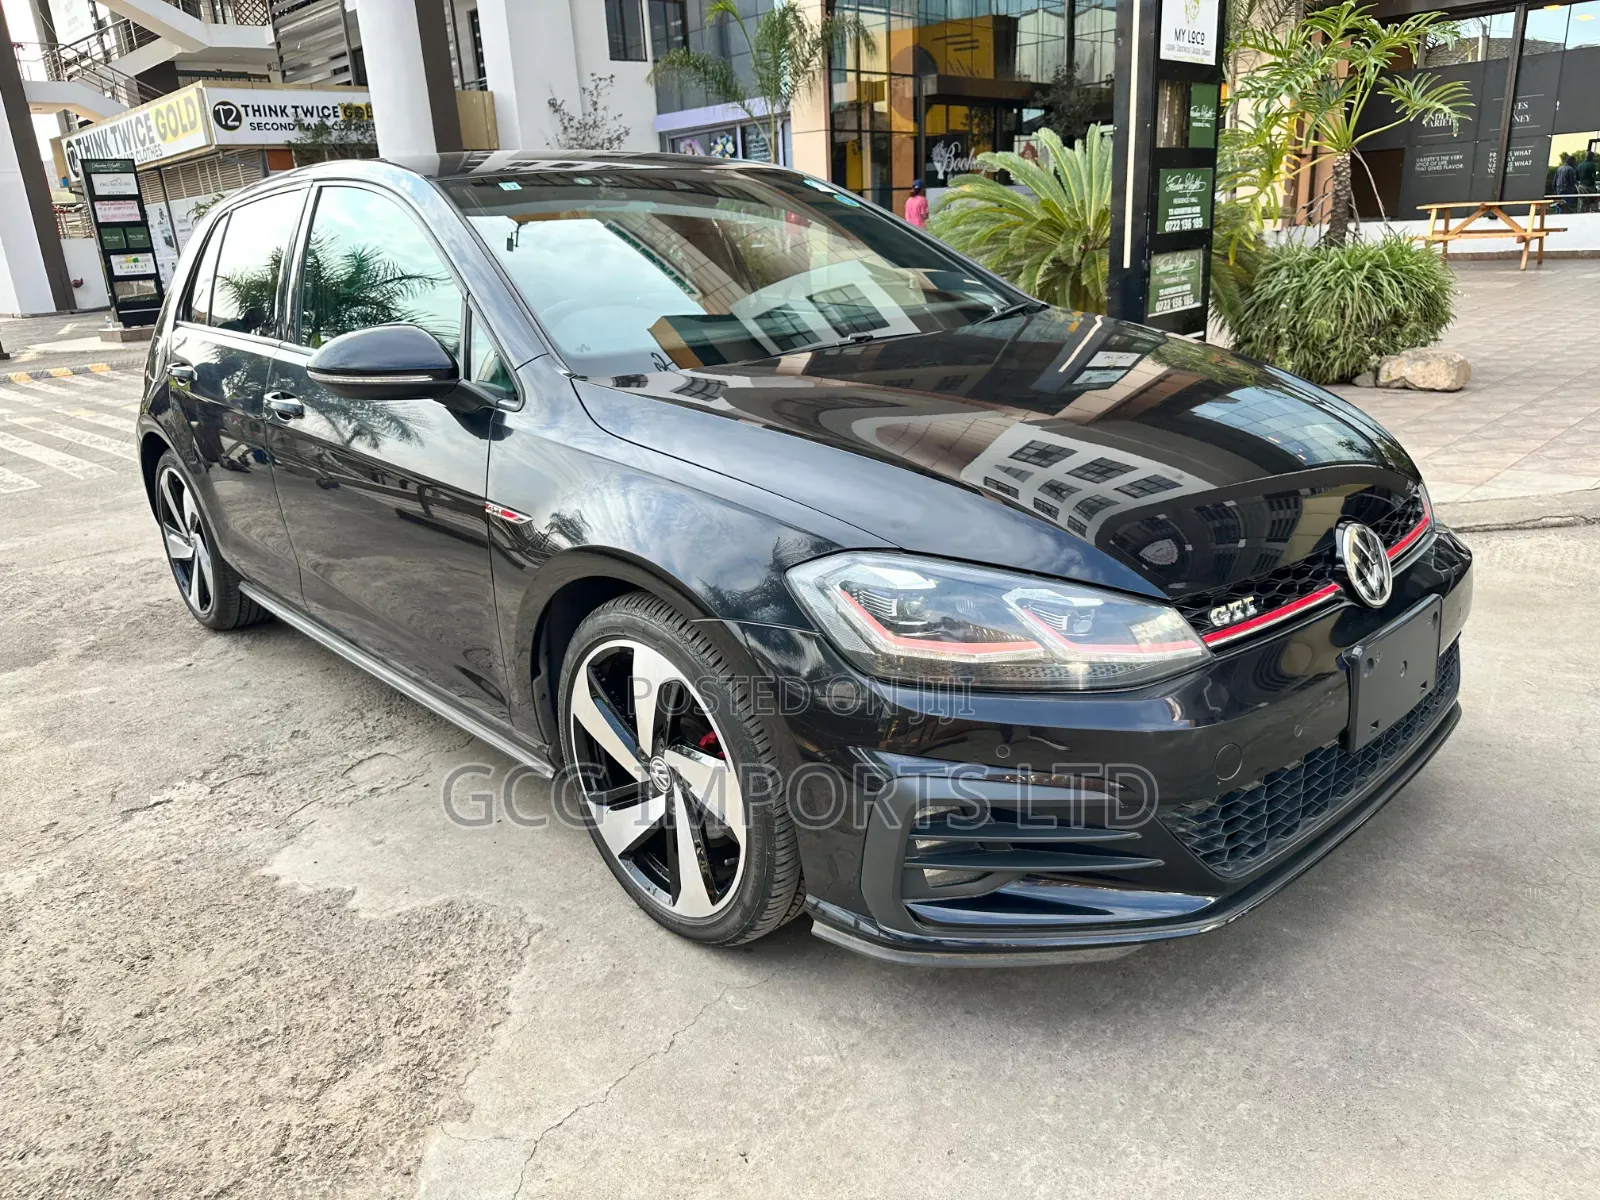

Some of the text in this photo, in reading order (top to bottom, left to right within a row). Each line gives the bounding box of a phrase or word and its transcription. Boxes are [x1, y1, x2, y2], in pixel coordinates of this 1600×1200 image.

[1174, 28, 1186, 42] MY
[241, 104, 289, 118] THINK
[291, 105, 340, 119] TWICE
[343, 104, 374, 120] GOL
[75, 128, 113, 159] THINK
[110, 113, 155, 156] TWICE
[155, 95, 197, 141] GOLD
[249, 122, 295, 131] SECOND
[136, 143, 163, 163] CLOTHES
[1210, 595, 1258, 627] GTI
